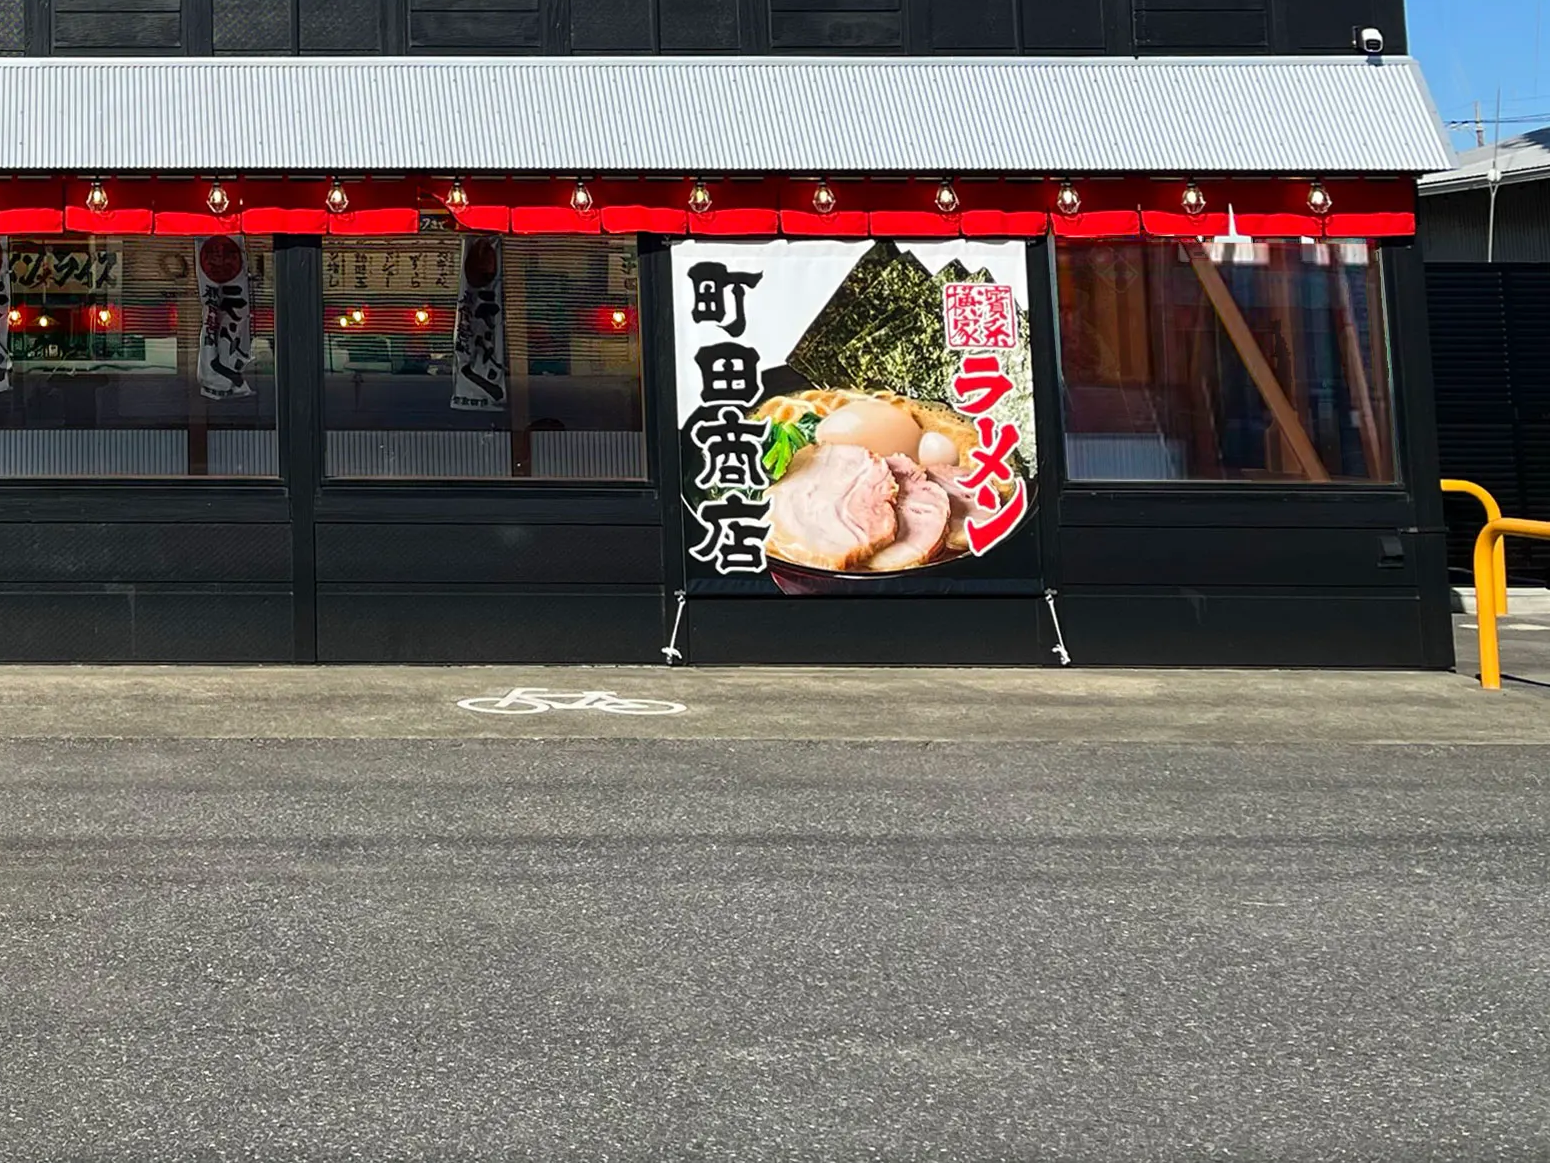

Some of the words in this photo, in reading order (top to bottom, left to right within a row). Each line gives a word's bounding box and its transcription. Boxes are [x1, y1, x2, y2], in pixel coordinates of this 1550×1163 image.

[687, 261, 772, 575] 町田商店
[953, 354, 1028, 556] ラーメン
